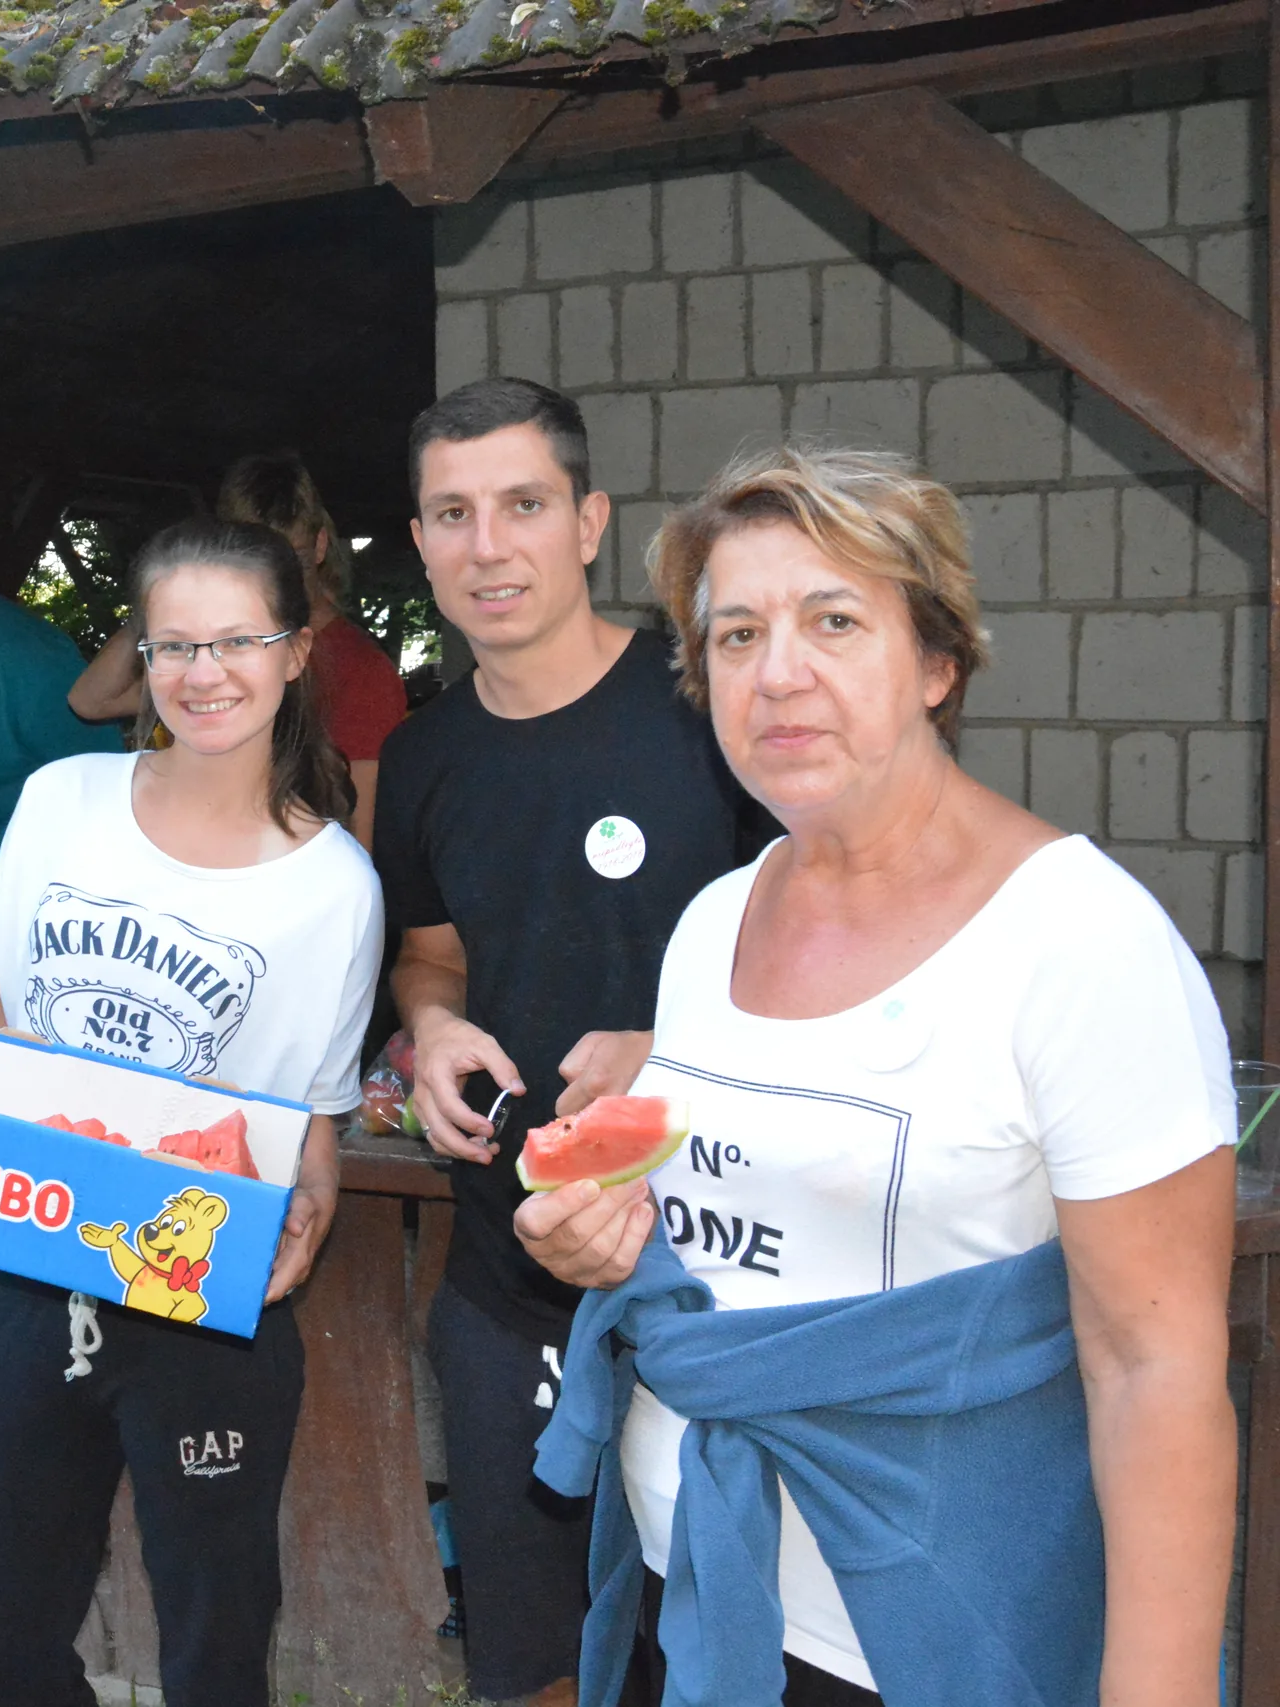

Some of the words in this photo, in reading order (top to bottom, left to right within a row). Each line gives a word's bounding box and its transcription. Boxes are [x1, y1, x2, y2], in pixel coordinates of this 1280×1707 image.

[31, 918, 104, 964] JACK
[92, 997, 151, 1032] Old
[80, 1016, 154, 1053] No.7
[663, 1195, 784, 1277] ONE
[179, 1430, 244, 1468] GAP
